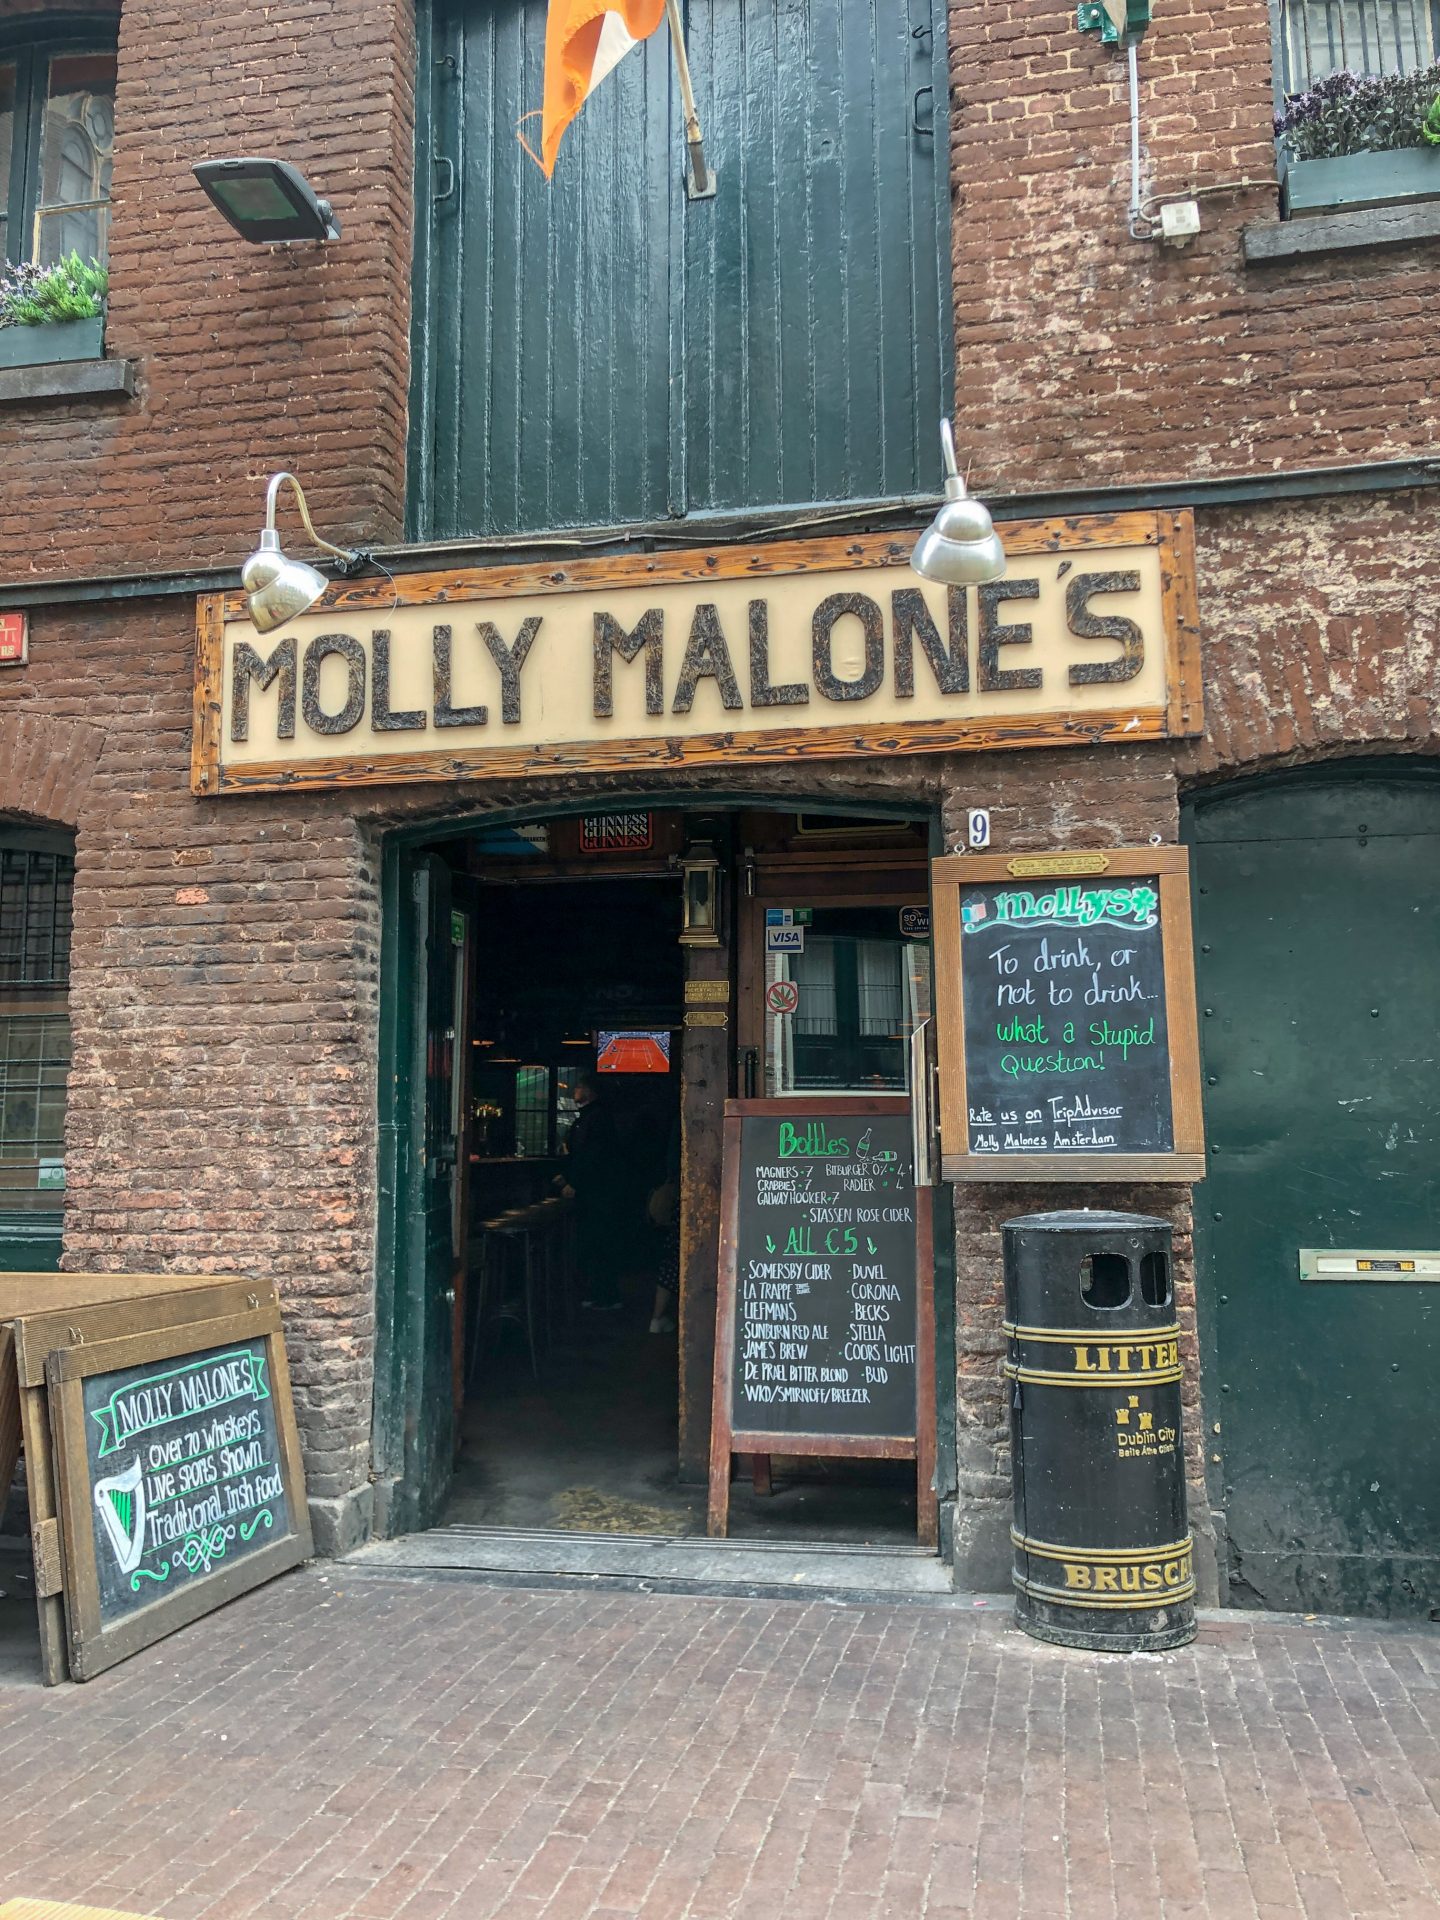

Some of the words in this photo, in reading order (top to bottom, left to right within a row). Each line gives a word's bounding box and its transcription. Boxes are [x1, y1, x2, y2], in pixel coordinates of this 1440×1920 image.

[231, 616, 543, 742] MOLLY
[584, 813, 648, 828] GUINNESS
[972, 814, 987, 844] 9
[584, 824, 648, 838] GUINNESS
[584, 834, 648, 848] GUINNESS
[773, 932, 800, 942] VISA
[988, 944, 1019, 975] To
[1111, 949, 1138, 967] or
[997, 978, 1036, 1006] not
[1049, 980, 1073, 1006] to
[1062, 1022, 1075, 1043] a
[969, 1107, 993, 1122] Rate
[1001, 1110, 1018, 1120] us
[1025, 1109, 1042, 1120] on
[1047, 1094, 1123, 1127] TripAdvisor
[780, 1122, 849, 1156] Bottles
[974, 1133, 999, 1151] Molly
[1004, 1133, 1047, 1146] Malones
[1053, 1127, 1114, 1145] Amsterdam
[756, 1166, 799, 1178] MAGNERS
[804, 1166, 813, 1177] 7
[825, 1163, 870, 1176] BITBURGER
[757, 1179, 796, 1191] CRABBIES
[804, 1180, 812, 1190] 7
[843, 1178, 876, 1191] RADLER
[757, 1191, 788, 1205] GALWAY
[790, 1191, 828, 1205] HOOKER
[832, 1192, 840, 1205] 7
[810, 1208, 852, 1223] STASSEN
[856, 1208, 880, 1223] ROSE
[882, 1208, 912, 1222] CIDER
[749, 1260, 803, 1279] SOMERSBY
[805, 1263, 832, 1280] CIDER
[852, 1263, 888, 1279] DUVEL
[743, 1280, 757, 1299] LA
[759, 1282, 793, 1300] TRAPPE
[851, 1282, 901, 1301] CORONA
[744, 1301, 797, 1321] LIEFMANS
[854, 1302, 890, 1321] BECKS
[744, 1321, 790, 1339] SUNBURN
[792, 1324, 810, 1340] RED
[812, 1325, 829, 1340] ALE
[849, 1323, 886, 1341] STELLA
[743, 1340, 776, 1359] JAMES
[780, 1342, 808, 1359] BREW
[844, 1342, 880, 1361] COORS
[884, 1344, 916, 1364] LIGHT
[762, 1363, 788, 1381] PRAEL
[790, 1365, 819, 1382] BITTER
[820, 1367, 849, 1383] BLOND
[865, 1366, 888, 1384] BUD
[117, 1382, 173, 1433] MOLLY
[178, 1358, 253, 1412] MALONES
[184, 1431, 200, 1456] 70
[1117, 1430, 1156, 1446] Dublin
[1158, 1427, 1176, 1442] City
[1118, 1447, 1140, 1457] Baile
[147, 1472, 176, 1504] Live
[146, 1485, 226, 1547] Traditional
[224, 1476, 256, 1515] Irish
[255, 1463, 284, 1504] food
